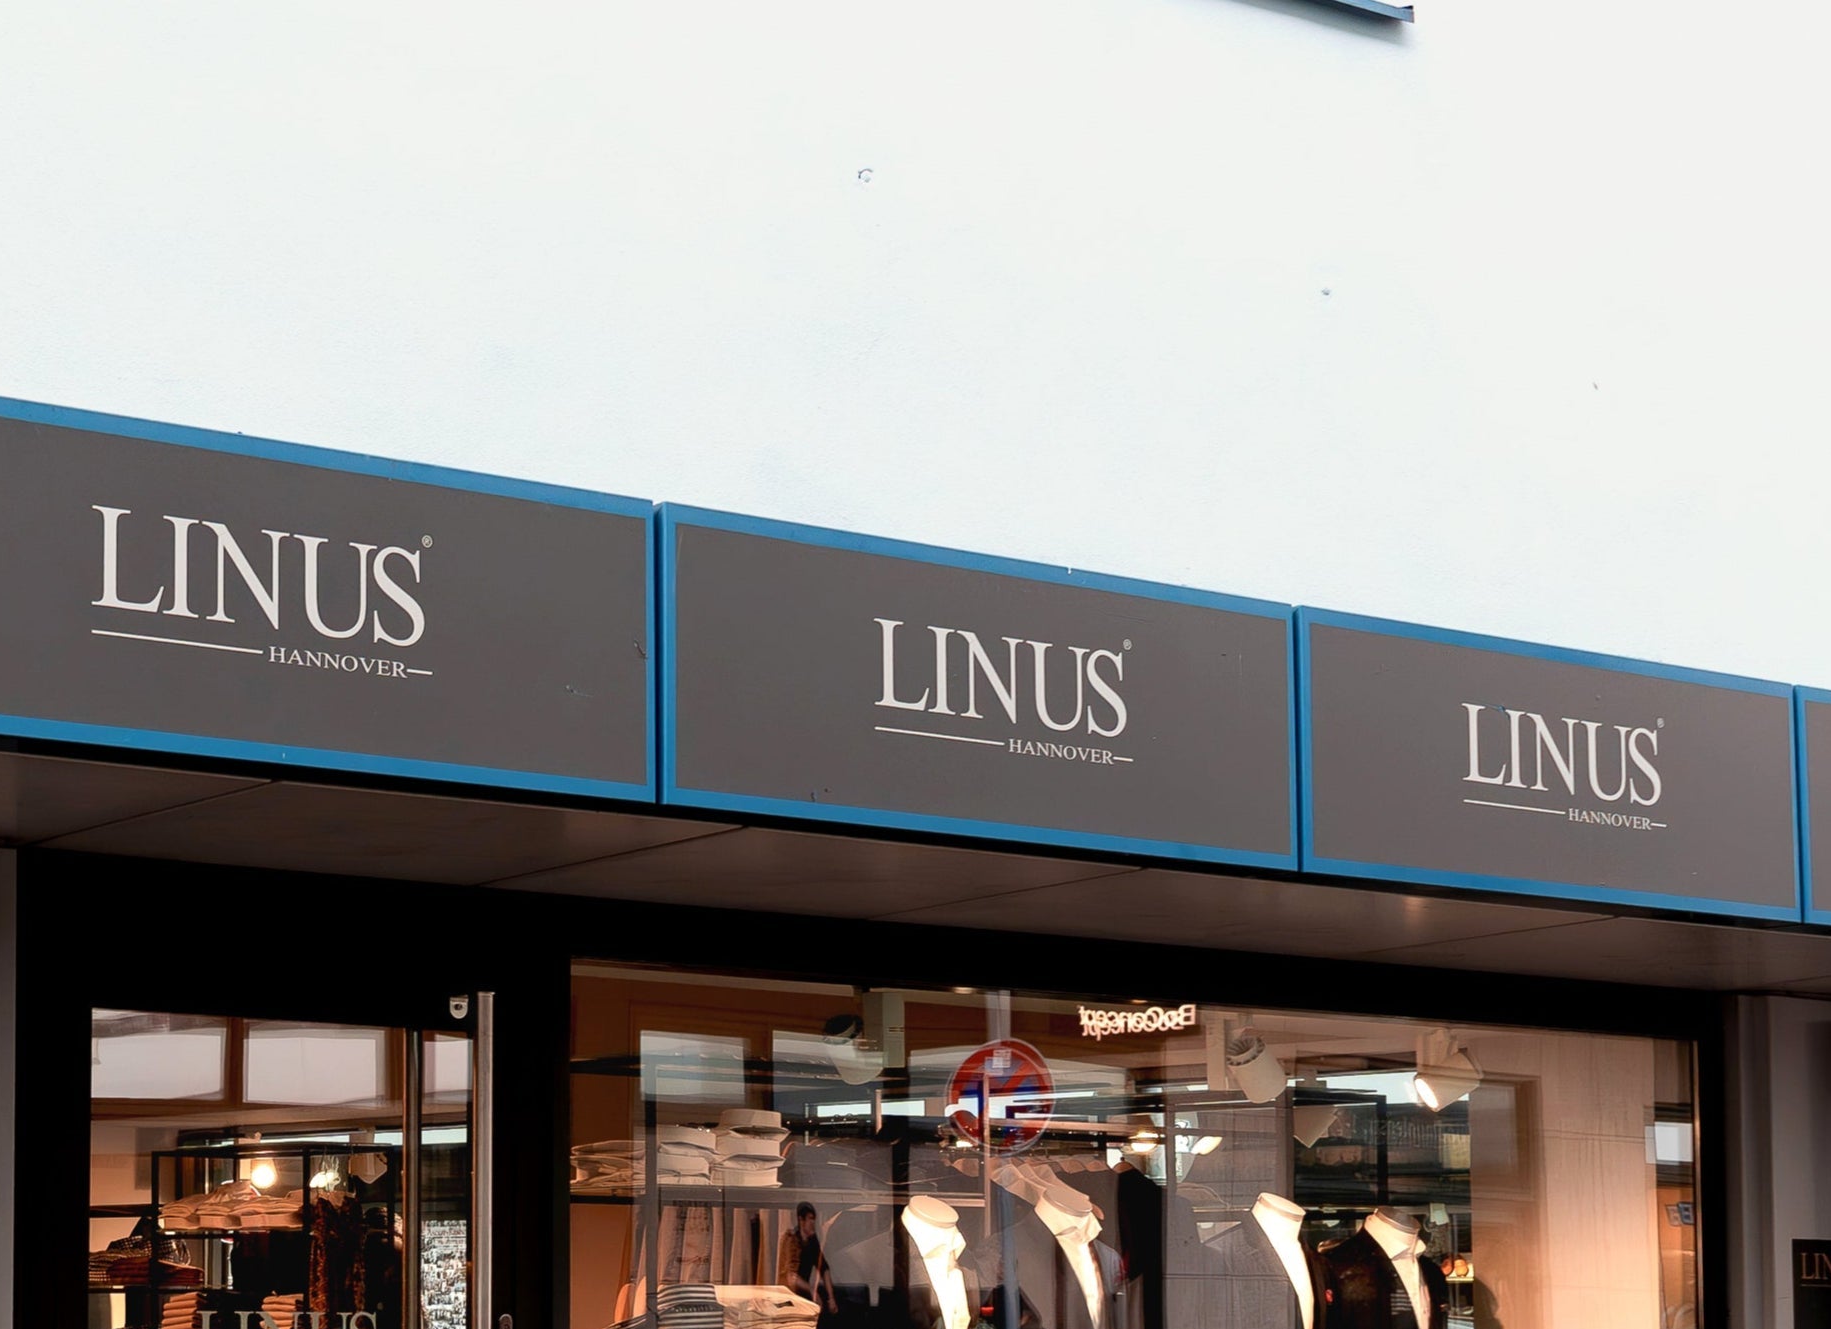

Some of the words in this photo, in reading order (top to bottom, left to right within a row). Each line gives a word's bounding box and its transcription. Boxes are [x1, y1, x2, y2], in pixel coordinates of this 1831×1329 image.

[91, 504, 426, 647] LINUS
[268, 645, 408, 679] HANNOVER
[873, 617, 1128, 738] LINUS
[1008, 738, 1115, 765] HANNOVER
[1461, 702, 1662, 806] LINUS
[1568, 808, 1652, 831] HANNOVER
